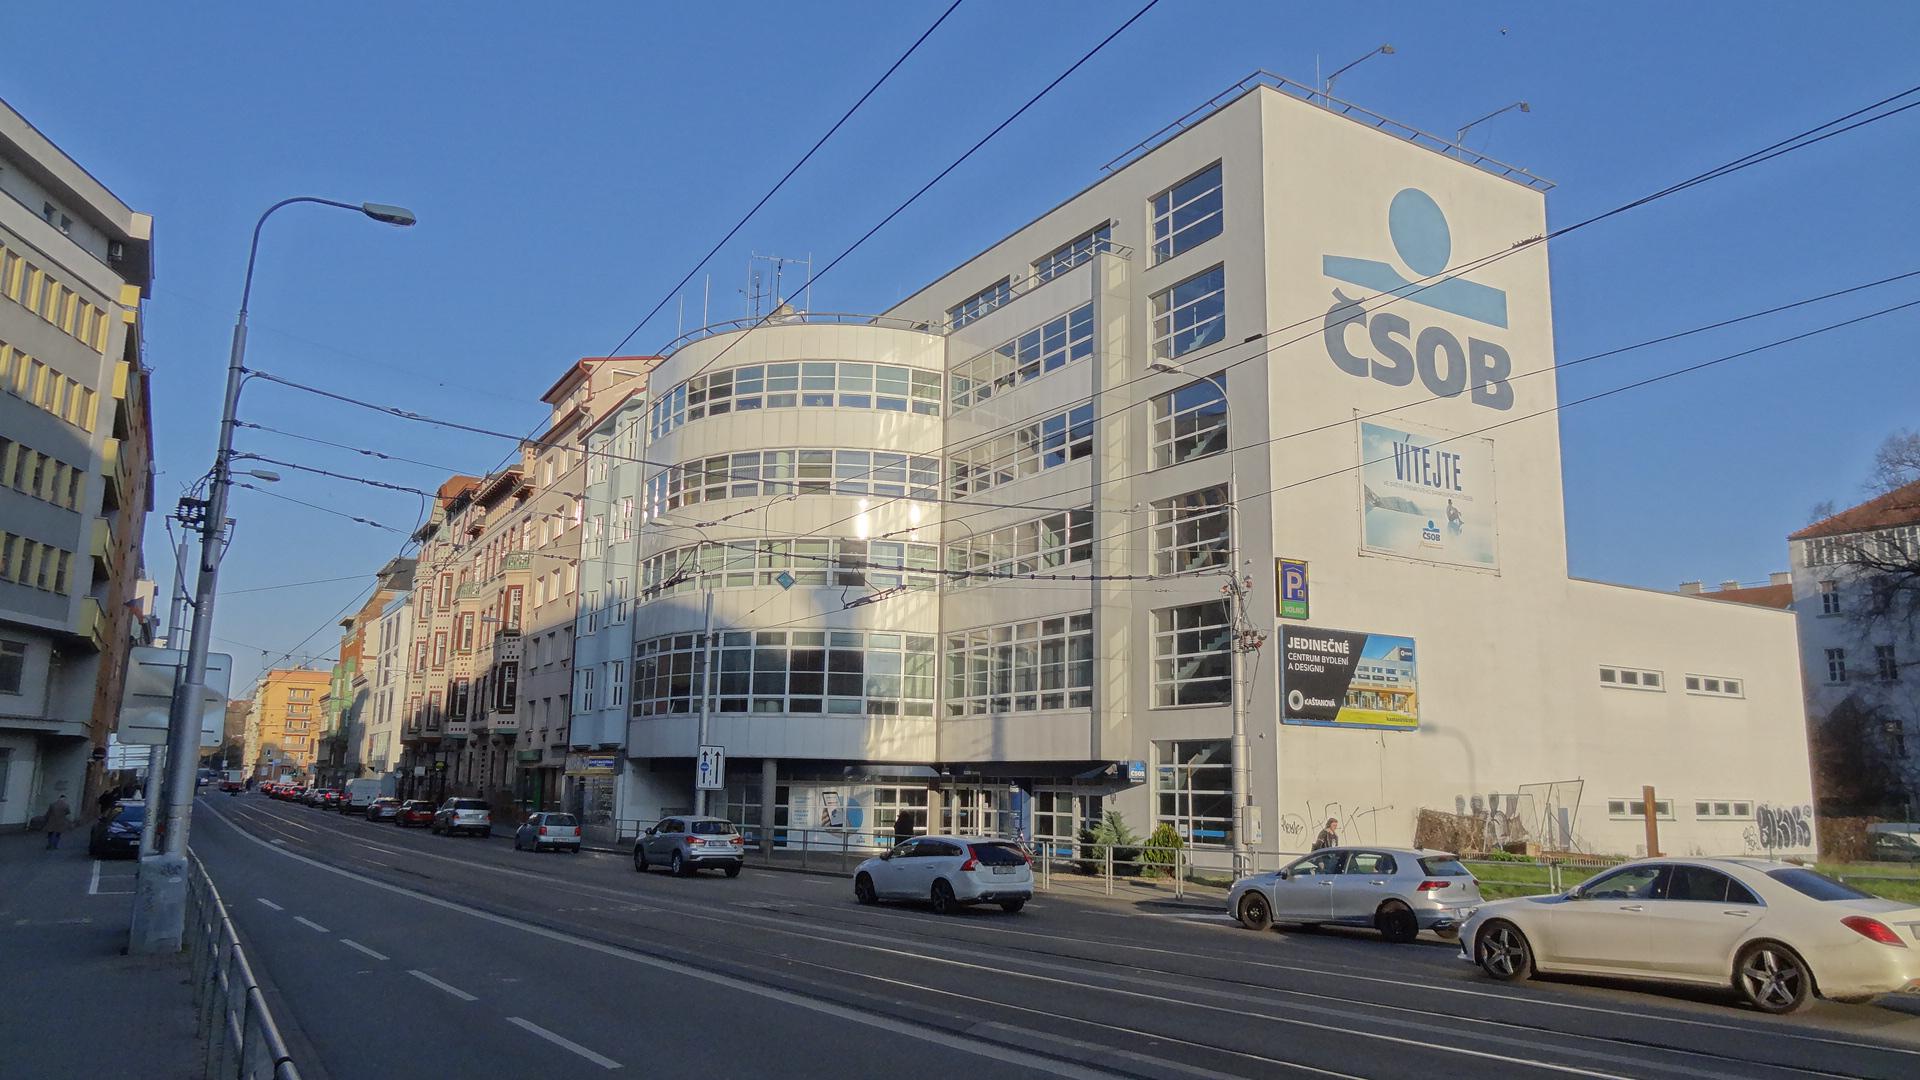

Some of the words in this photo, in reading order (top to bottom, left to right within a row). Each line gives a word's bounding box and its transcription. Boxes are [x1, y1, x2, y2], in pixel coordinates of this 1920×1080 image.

[1323, 287, 1515, 412] ČSOB
[1393, 433, 1462, 492] VÍTEJTE
[1287, 571, 1302, 598] P
[1288, 637, 1350, 654] JEDINEČNÉ
[1287, 652, 1321, 663] CENTRUM
[1321, 655, 1349, 666] BYDLENÍ
[1287, 662, 1294, 671] A
[1294, 662, 1325, 673] DESIGNU
[1304, 697, 1336, 707] KAŠTANOVÁ
